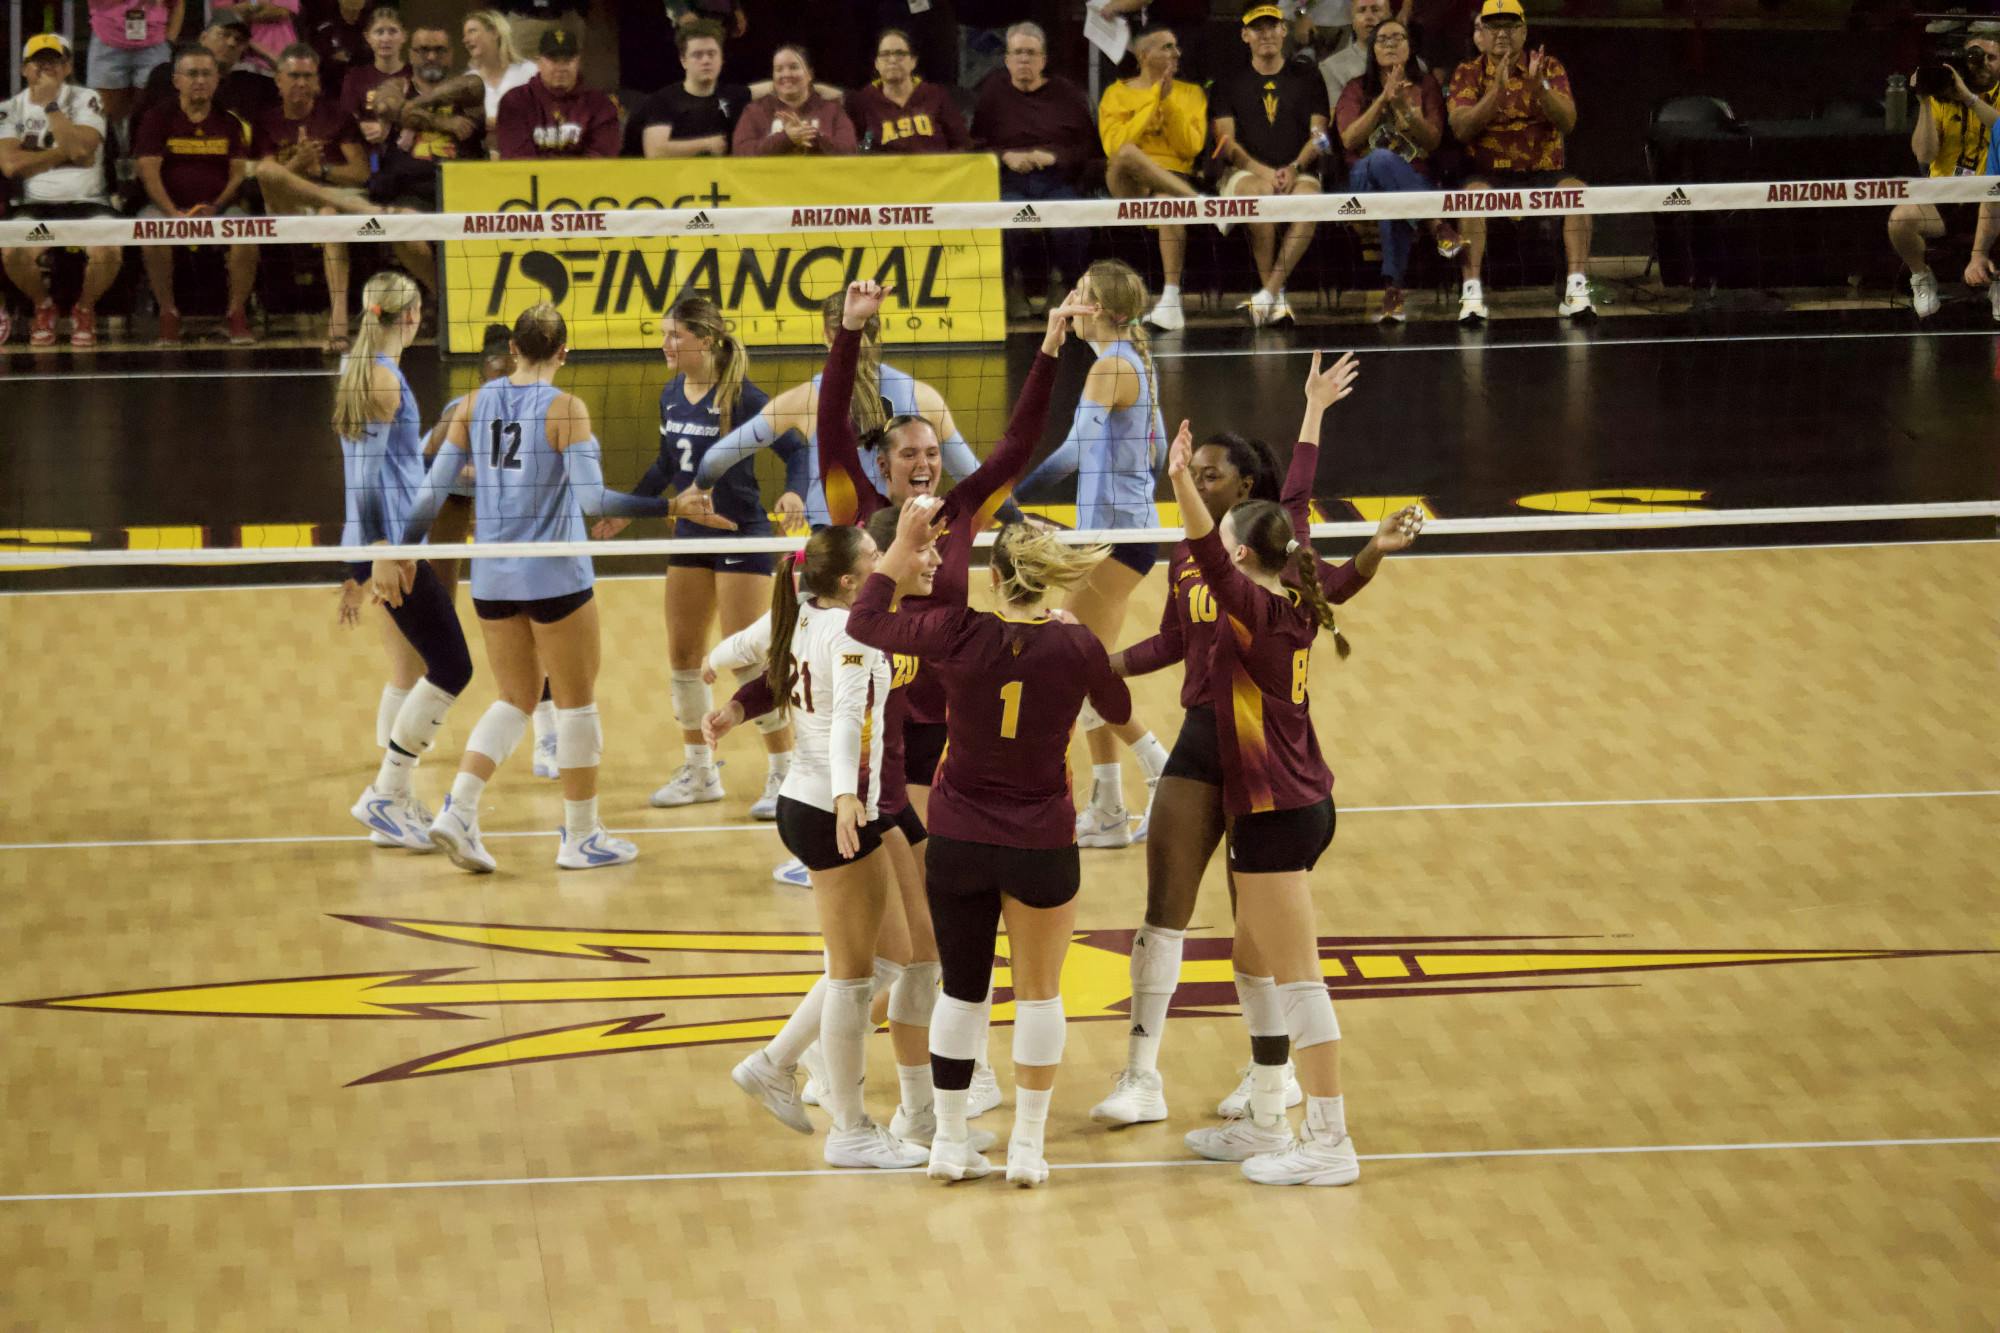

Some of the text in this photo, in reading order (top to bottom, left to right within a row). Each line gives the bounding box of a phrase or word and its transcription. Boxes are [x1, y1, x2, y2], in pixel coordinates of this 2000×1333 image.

[881, 114, 934, 145] ASU
[1442, 190, 1585, 212] ARIZONA STATE
[1663, 198, 1691, 206] adidas
[1767, 180, 1910, 202] ARIZONA STATE
[791, 206, 934, 227] ARIZONA STATE
[1013, 214, 1041, 223] adidas
[1117, 198, 1260, 220] ARIZONA STATE
[1338, 206, 1366, 215] adidas
[132, 218, 278, 240] ARIZONA STATE
[357, 228, 386, 236] adidas
[463, 213, 607, 234] ARIZONA STATE
[686, 221, 714, 230] adidas
[25, 233, 55, 242] adidas
[552, 246, 952, 314] FINANCIAL
[640, 319, 786, 335] CDIT
[682, 422, 720, 437] DIEGO
[490, 418, 522, 470] 12
[676, 438, 694, 473] 2
[1188, 584, 1217, 624] 10
[890, 653, 919, 690] 20
[1292, 649, 1308, 704] 8
[1000, 681, 1023, 739] 1
